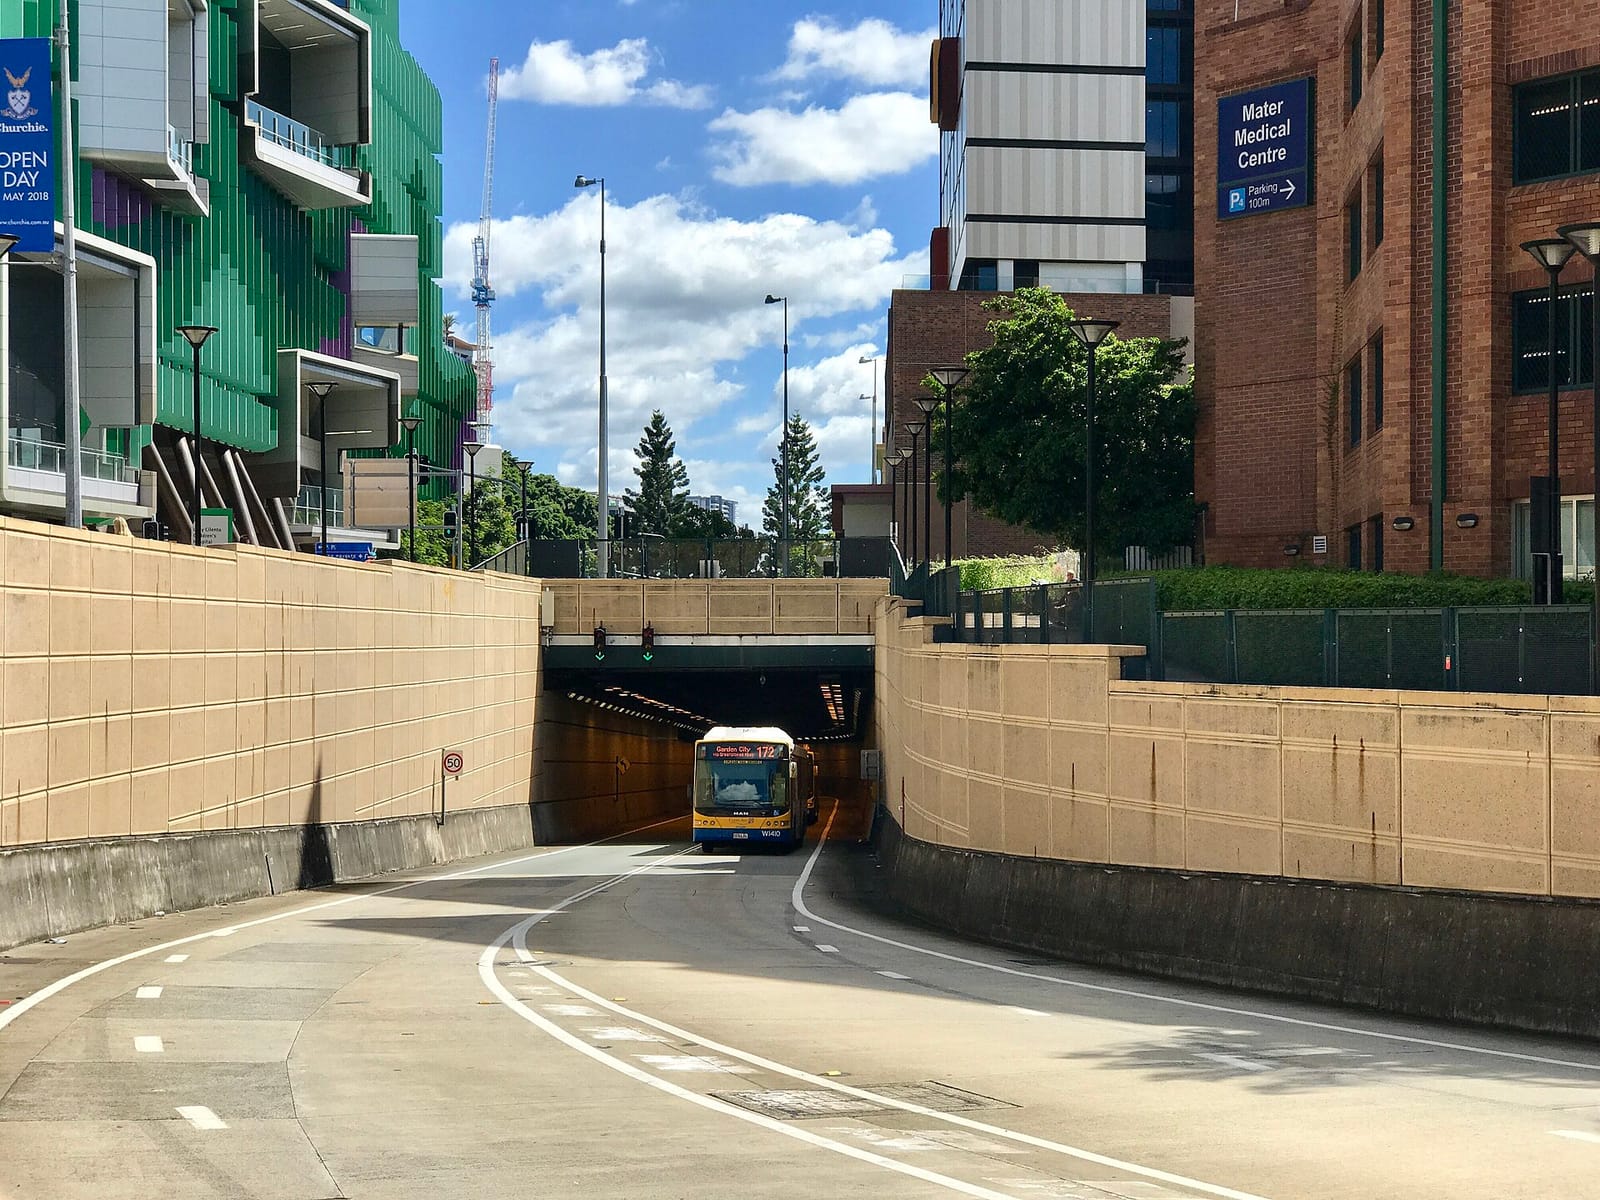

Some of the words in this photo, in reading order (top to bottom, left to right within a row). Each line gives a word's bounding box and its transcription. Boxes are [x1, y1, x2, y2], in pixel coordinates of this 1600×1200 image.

[1242, 100, 1284, 122] Mater
[0, 122, 48, 132] hurchie.
[1234, 118, 1291, 147] Medical
[0, 151, 47, 168] OPEN
[1238, 147, 1287, 169] Centre
[3, 171, 39, 187] DAY
[28, 192, 48, 200] 2018
[1248, 183, 1278, 196] Parking
[1248, 198, 1270, 209] 100m
[756, 746, 774, 758] 172
[447, 758, 460, 768] 50
